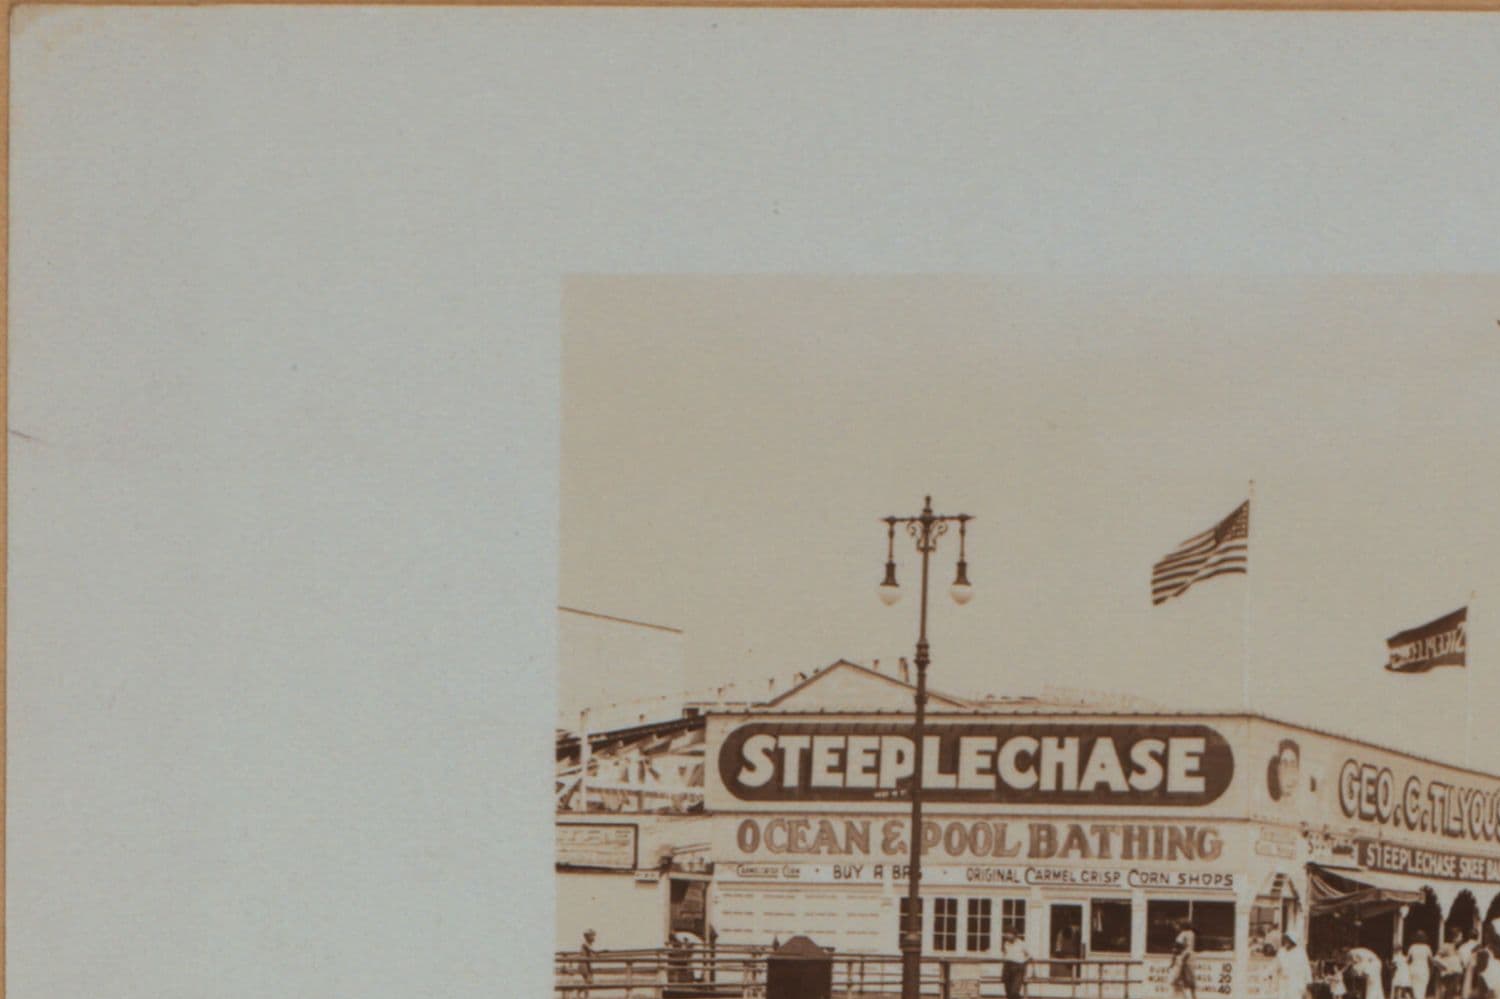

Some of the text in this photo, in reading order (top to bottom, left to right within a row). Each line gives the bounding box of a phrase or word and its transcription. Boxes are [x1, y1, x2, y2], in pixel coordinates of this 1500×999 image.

[737, 734, 1206, 793] STEEPLECHASE
[737, 818, 871, 855] OCEAN
[881, 822, 907, 856] &
[921, 821, 1022, 858] POOL
[1027, 823, 1224, 862] BATHING
[833, 865, 922, 879] BUY A BA
[966, 868, 1020, 884] ORIGINAL
[1025, 867, 1076, 885] CARMEL
[1128, 870, 1171, 888] CORN
[1178, 873, 1234, 887] SHOPS
[1366, 842, 1456, 878] STEEPLECHASE
